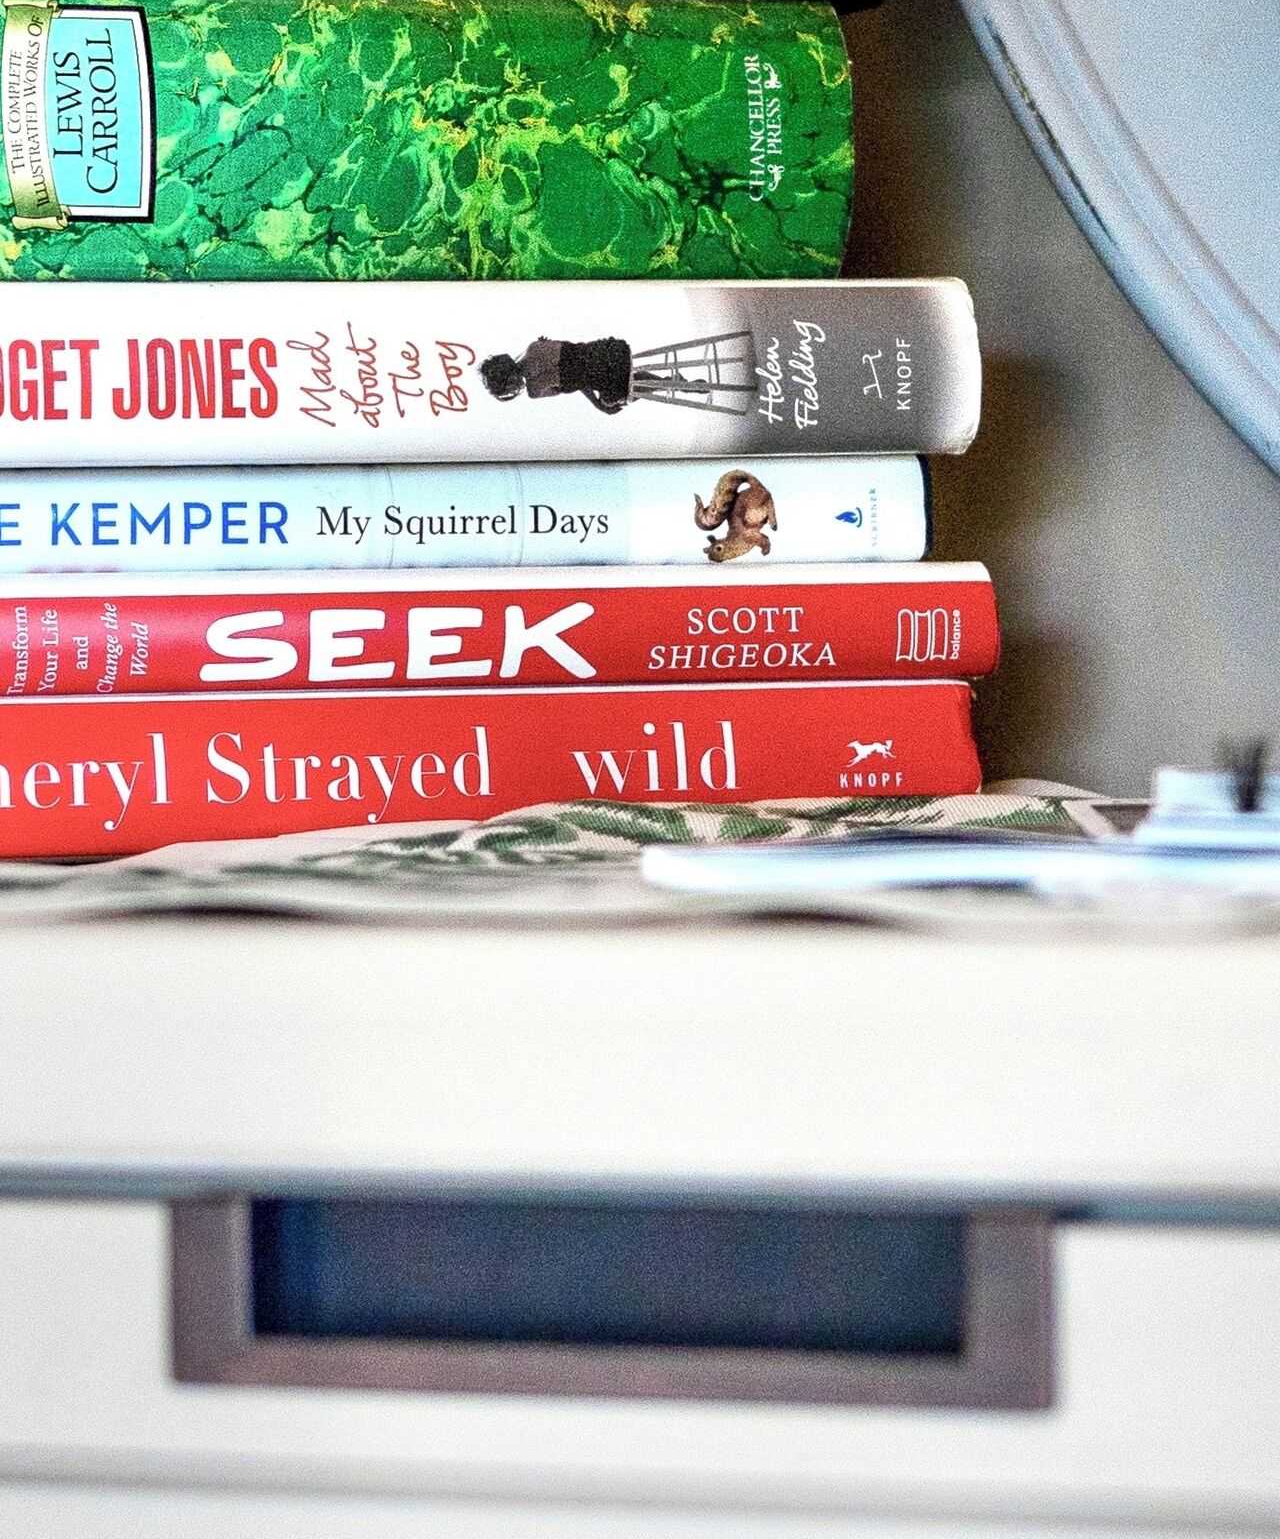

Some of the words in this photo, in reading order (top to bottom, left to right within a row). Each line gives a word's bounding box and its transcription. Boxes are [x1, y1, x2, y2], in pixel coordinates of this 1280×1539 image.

[27, 15, 44, 38] OF
[7, 50, 23, 134] COMPLETE
[23, 40, 40, 99] WORKS
[53, 51, 83, 158] LEWIS
[85, 28, 119, 194] CARROLL
[744, 54, 765, 202] CHANCELLOR
[766, 97, 783, 155] PRESS
[11, 138, 25, 174] THE
[25, 101, 50, 207] ILLUSTRATED
[112, 337, 278, 420] JONES
[286, 331, 336, 427] Mad
[339, 321, 384, 428] about
[387, 340, 425, 418] The
[429, 340, 476, 417] Boy
[755, 336, 785, 424] Helen
[788, 319, 826, 429] Fielding
[896, 337, 912, 410] KNOPF
[50, 501, 289, 546] KEMPER
[316, 505, 372, 545] My
[384, 504, 517, 545] Squirrel
[529, 504, 609, 543] Days
[7, 605, 28, 695] Transform
[40, 609, 59, 646] Life
[99, 602, 118, 630] the
[129, 621, 149, 677] World
[199, 601, 597, 682] SEEK
[687, 606, 804, 635] SCOTT
[949, 609, 961, 660] balance
[37, 653, 59, 692] Your
[72, 635, 89, 671] and
[96, 634, 124, 693] Change
[648, 642, 837, 670] SHIGEOKA
[206, 726, 496, 824] Strayed
[570, 720, 742, 795] wild
[839, 771, 904, 789] KNOPF
